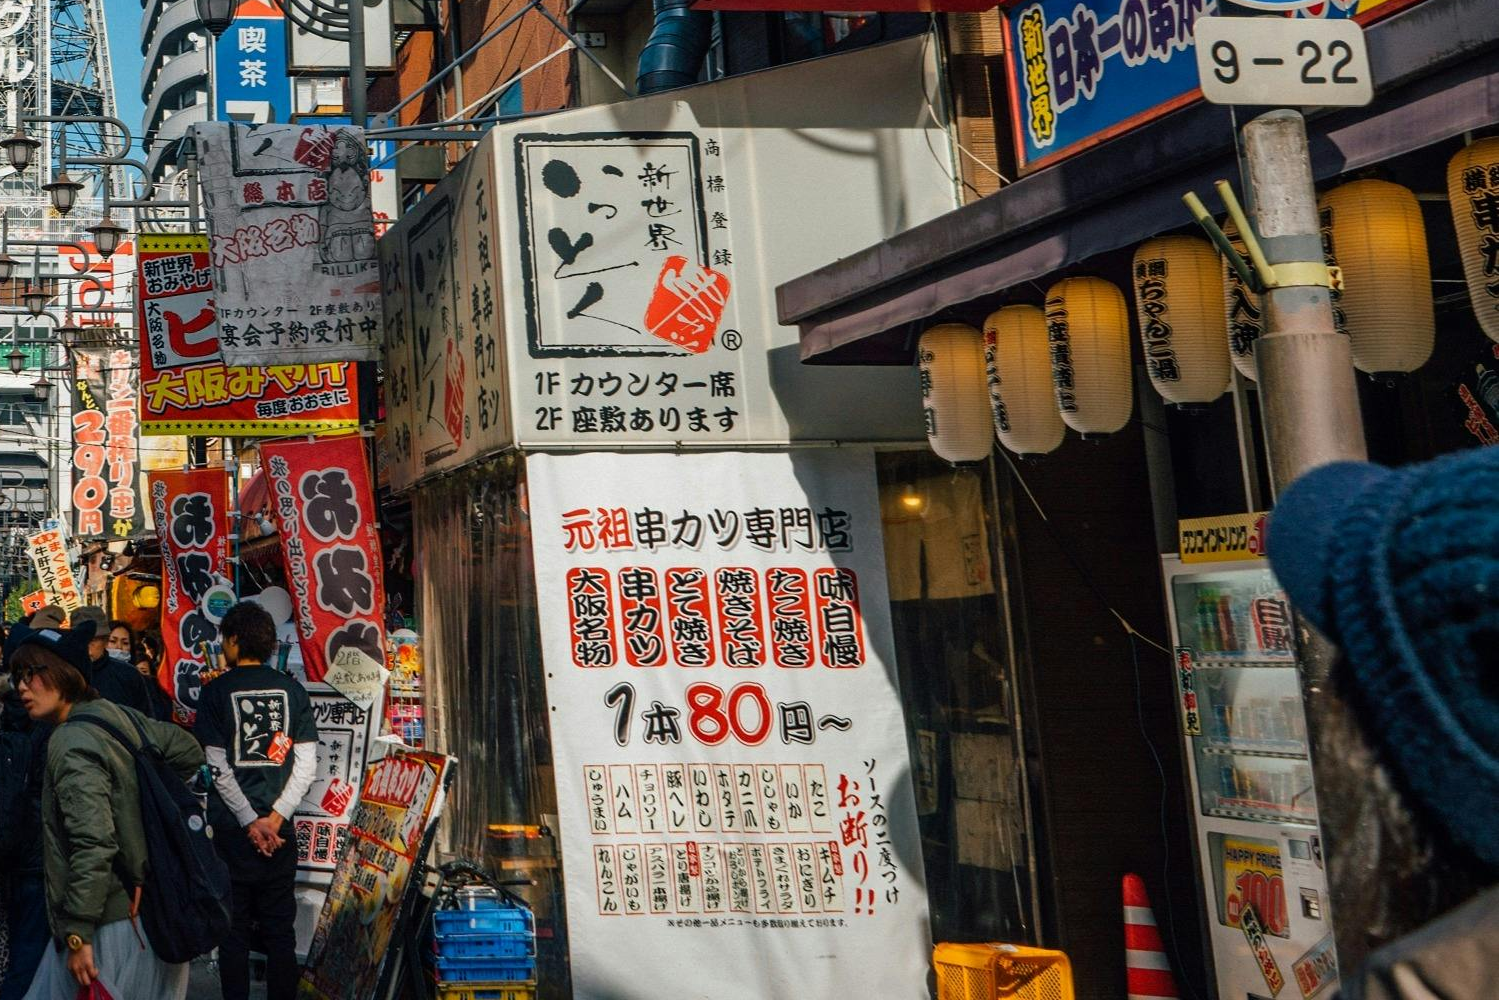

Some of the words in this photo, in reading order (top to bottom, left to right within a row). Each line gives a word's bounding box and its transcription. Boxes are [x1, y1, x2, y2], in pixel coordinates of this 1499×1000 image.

[238, 26, 267, 88] 喫茶
[1020, 6, 1054, 142] 新世界
[638, 162, 683, 251] 新世界
[704, 138, 732, 267] 商標登録
[144, 255, 194, 277] 新世界
[147, 269, 211, 294] おみやげ
[147, 301, 168, 367] 大阪名物
[221, 316, 378, 348] 宴会予約受付中
[256, 391, 350, 418] 毎度おおきに
[534, 371, 561, 395] 1F
[569, 371, 737, 398] カウンター席
[534, 406, 563, 431] 2F
[571, 406, 739, 433] 座敷あります
[72, 408, 108, 537] 290円
[561, 506, 854, 552] 元祖串カツ専門店
[572, 569, 612, 666] 大阪名物
[621, 568, 661, 665] 串カツ
[670, 570, 710, 666] どて焼き
[718, 569, 760, 666] 焼きそば
[770, 569, 810, 666] たこ焼き
[817, 569, 861, 667] 味自慢
[588, 769, 608, 831] しゅうまい
[615, 784, 633, 820] ハム
[639, 769, 658, 831] チョリソー
[666, 770, 686, 828] 豚ヘレ
[693, 769, 712, 828] いわし
[717, 770, 736, 830] ホタテ
[738, 770, 758, 828] カニ爪
[760, 768, 781, 831] ししゃも
[786, 782, 803, 820] いか
[810, 779, 827, 818] たこ
[862, 758, 900, 905] ソースの二度つけ
[1225, 848, 1254, 864] HAPPY
[1256, 852, 1282, 870] PRICE
[598, 848, 618, 911] れんこん
[622, 847, 641, 911] じゃがいも
[797, 848, 816, 908] おにぎり
[819, 846, 836, 905] キムチ
[1236, 869, 1287, 935] 100
